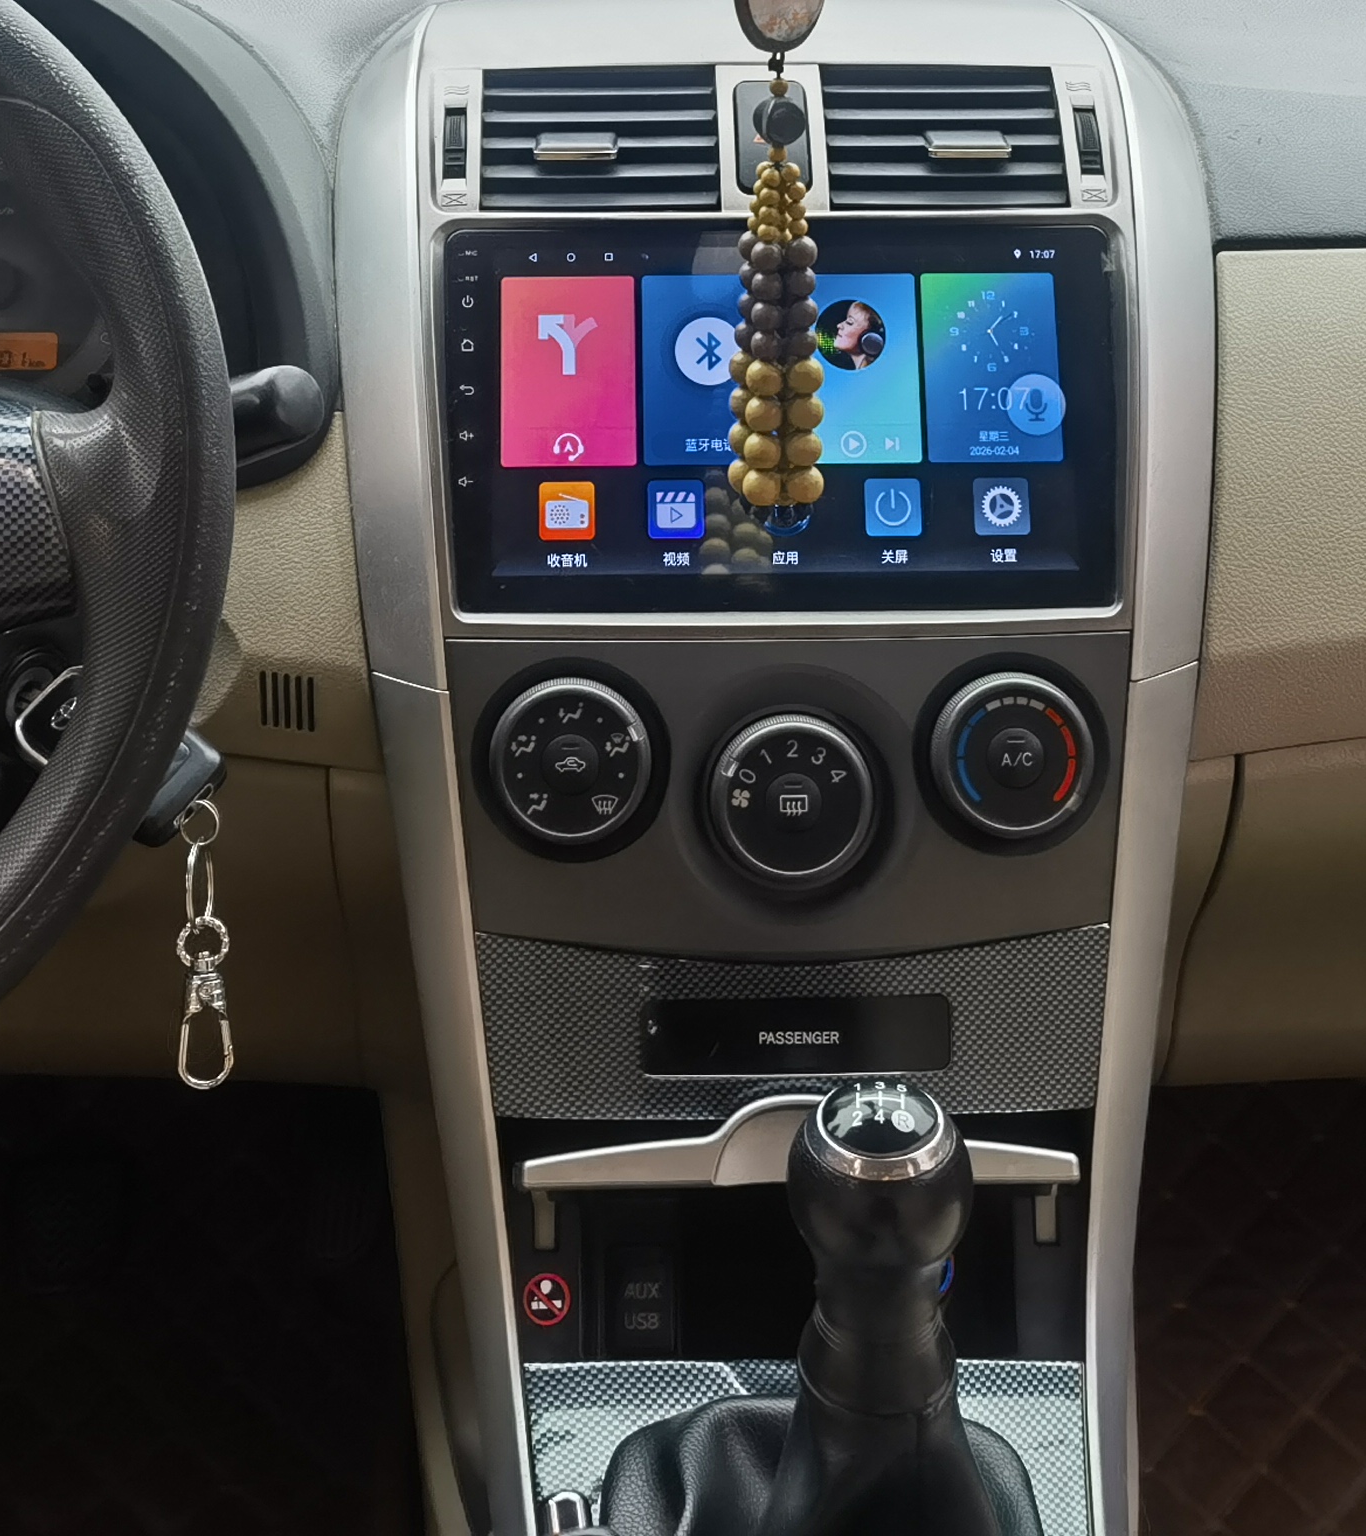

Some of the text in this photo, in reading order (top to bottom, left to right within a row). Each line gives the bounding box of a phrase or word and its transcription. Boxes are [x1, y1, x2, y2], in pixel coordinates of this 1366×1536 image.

[1029, 250, 1056, 259] 17:07
[958, 387, 1031, 410] 17:07
[979, 431, 1009, 442] 星期三
[969, 446, 1019, 456] 2026-02-04
[547, 552, 588, 568] 收音机
[662, 551, 691, 566] 视频
[772, 550, 799, 565] 应用
[881, 549, 909, 565] 关屏
[990, 548, 1018, 563] 设置
[760, 748, 772, 764] 1
[786, 739, 799, 758] 2
[811, 747, 826, 765] 3
[1001, 752, 1033, 766] A/C
[739, 768, 756, 784] 0
[830, 769, 847, 783] 4
[758, 1031, 840, 1045] PASSENGER
[853, 1081, 908, 1092] 1 3 5
[851, 1109, 910, 1129] 2 4 R
[624, 1282, 660, 1299] AUX
[624, 1312, 660, 1330] USB
